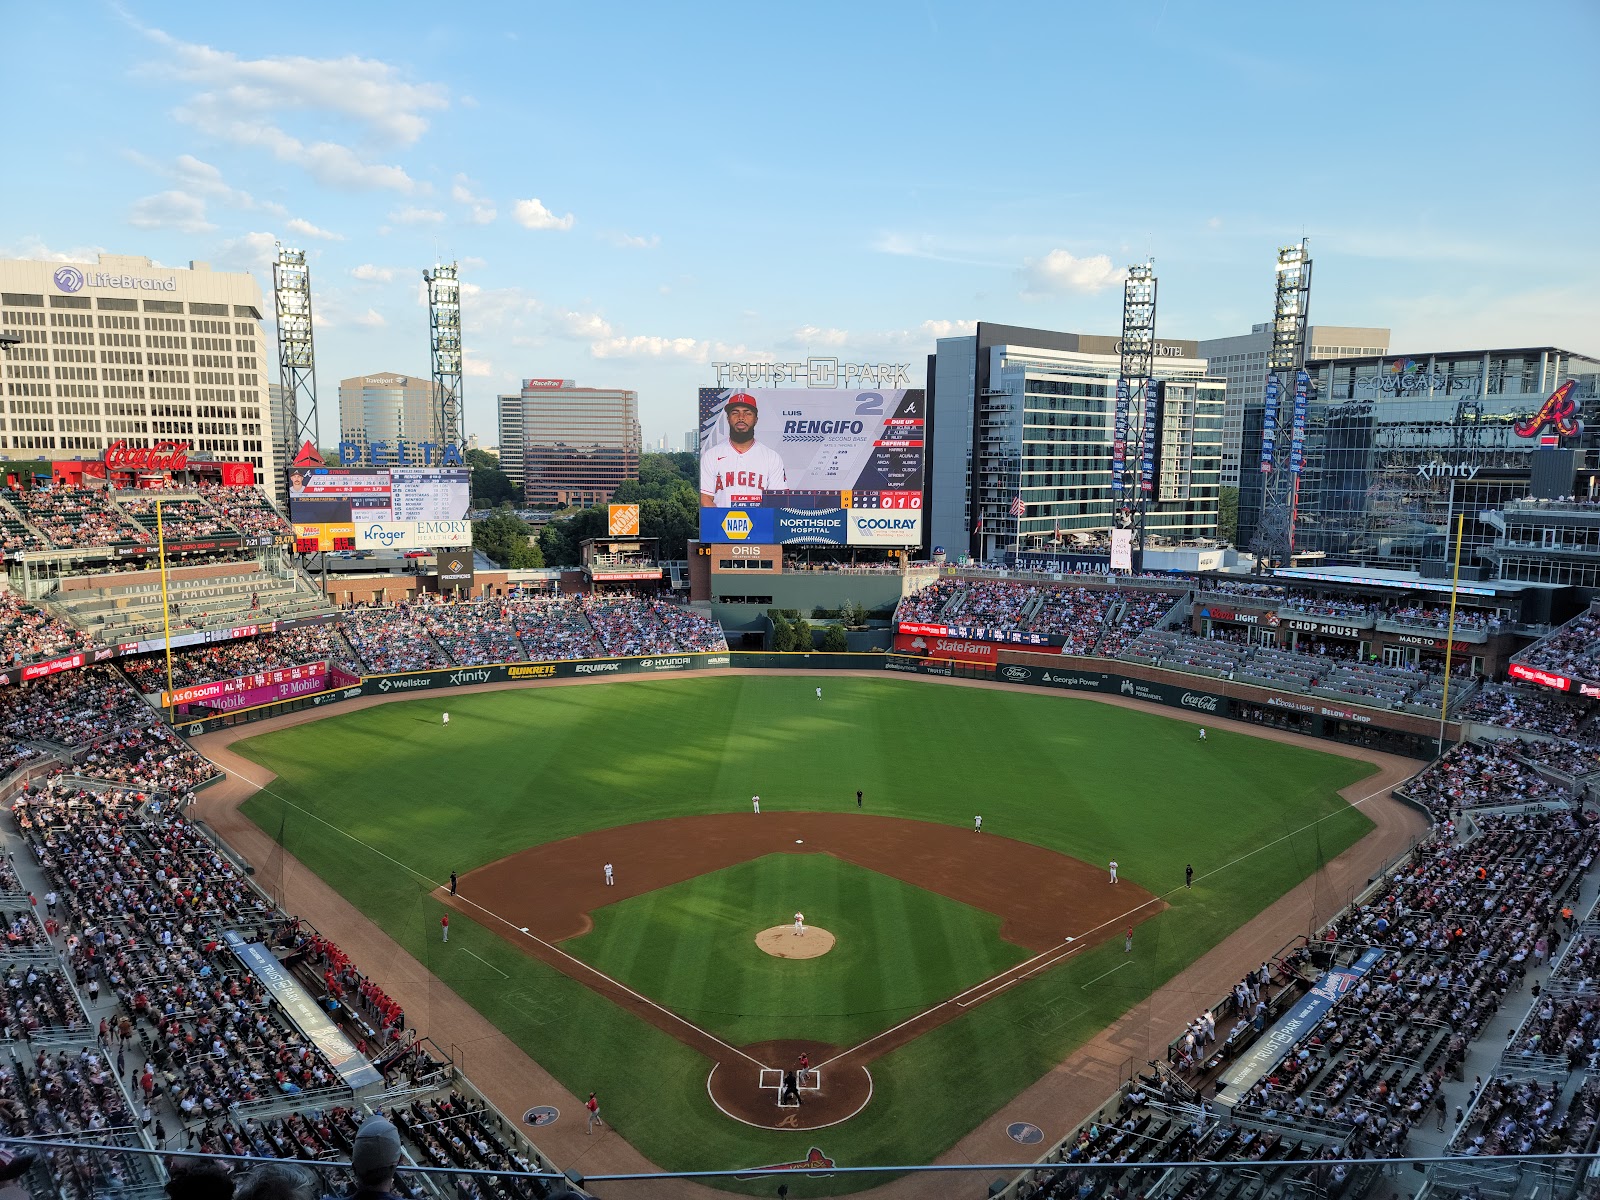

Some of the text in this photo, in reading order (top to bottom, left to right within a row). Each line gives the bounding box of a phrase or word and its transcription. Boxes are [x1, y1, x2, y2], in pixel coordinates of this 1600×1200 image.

[87, 272, 176, 291] LifeBrand
[1153, 343, 1185, 357] HOTEL
[712, 362, 911, 383] TRUIST PARK
[365, 377, 393, 385] Travelport
[533, 380, 560, 388] RaceTrac
[1357, 373, 1449, 390] COMCAST
[854, 392, 884, 416] 2
[783, 420, 864, 435] RENGIFO
[105, 439, 191, 470] Coca-Cola
[338, 442, 463, 465] DELTA
[1417, 460, 1480, 480] xfinity
[882, 497, 921, 508] 0 1 0
[610, 504, 639, 534] HOME
[612, 508, 625, 520] THE
[417, 521, 469, 534] EMORY
[621, 516, 639, 534] DEPOT
[727, 520, 748, 532] NAPA
[780, 519, 841, 527] NORTHSIDE
[857, 518, 917, 529] COOLRAY
[364, 524, 406, 546] Kroger
[14, 552, 25, 561] 42
[732, 546, 760, 555] ORIS
[1016, 559, 1044, 570] PLAY
[1210, 608, 1258, 623] Coors LIGHT
[1289, 621, 1359, 637] CHOP HOUSE
[1400, 636, 1422, 644] MADE
[508, 666, 556, 676] QUIKRETE
[575, 663, 620, 673] EQUIFAX
[393, 678, 430, 688] Wellstar
[450, 669, 491, 685] xfinity
[1053, 675, 1099, 686] Georgia Power
[192, 686, 220, 698] SOUTH
[291, 679, 320, 694] Mobile
[211, 695, 246, 709] Mobile
[1275, 697, 1314, 712] Coors LIGHT
[1322, 708, 1371, 723] BELOW CHOP
[262, 964, 300, 1003] TRUIST PARK
[1309, 972, 1342, 1001] Braves
[1253, 1018, 1303, 1062] TRUIST PARK
[1231, 1066, 1252, 1085] WELCOME
